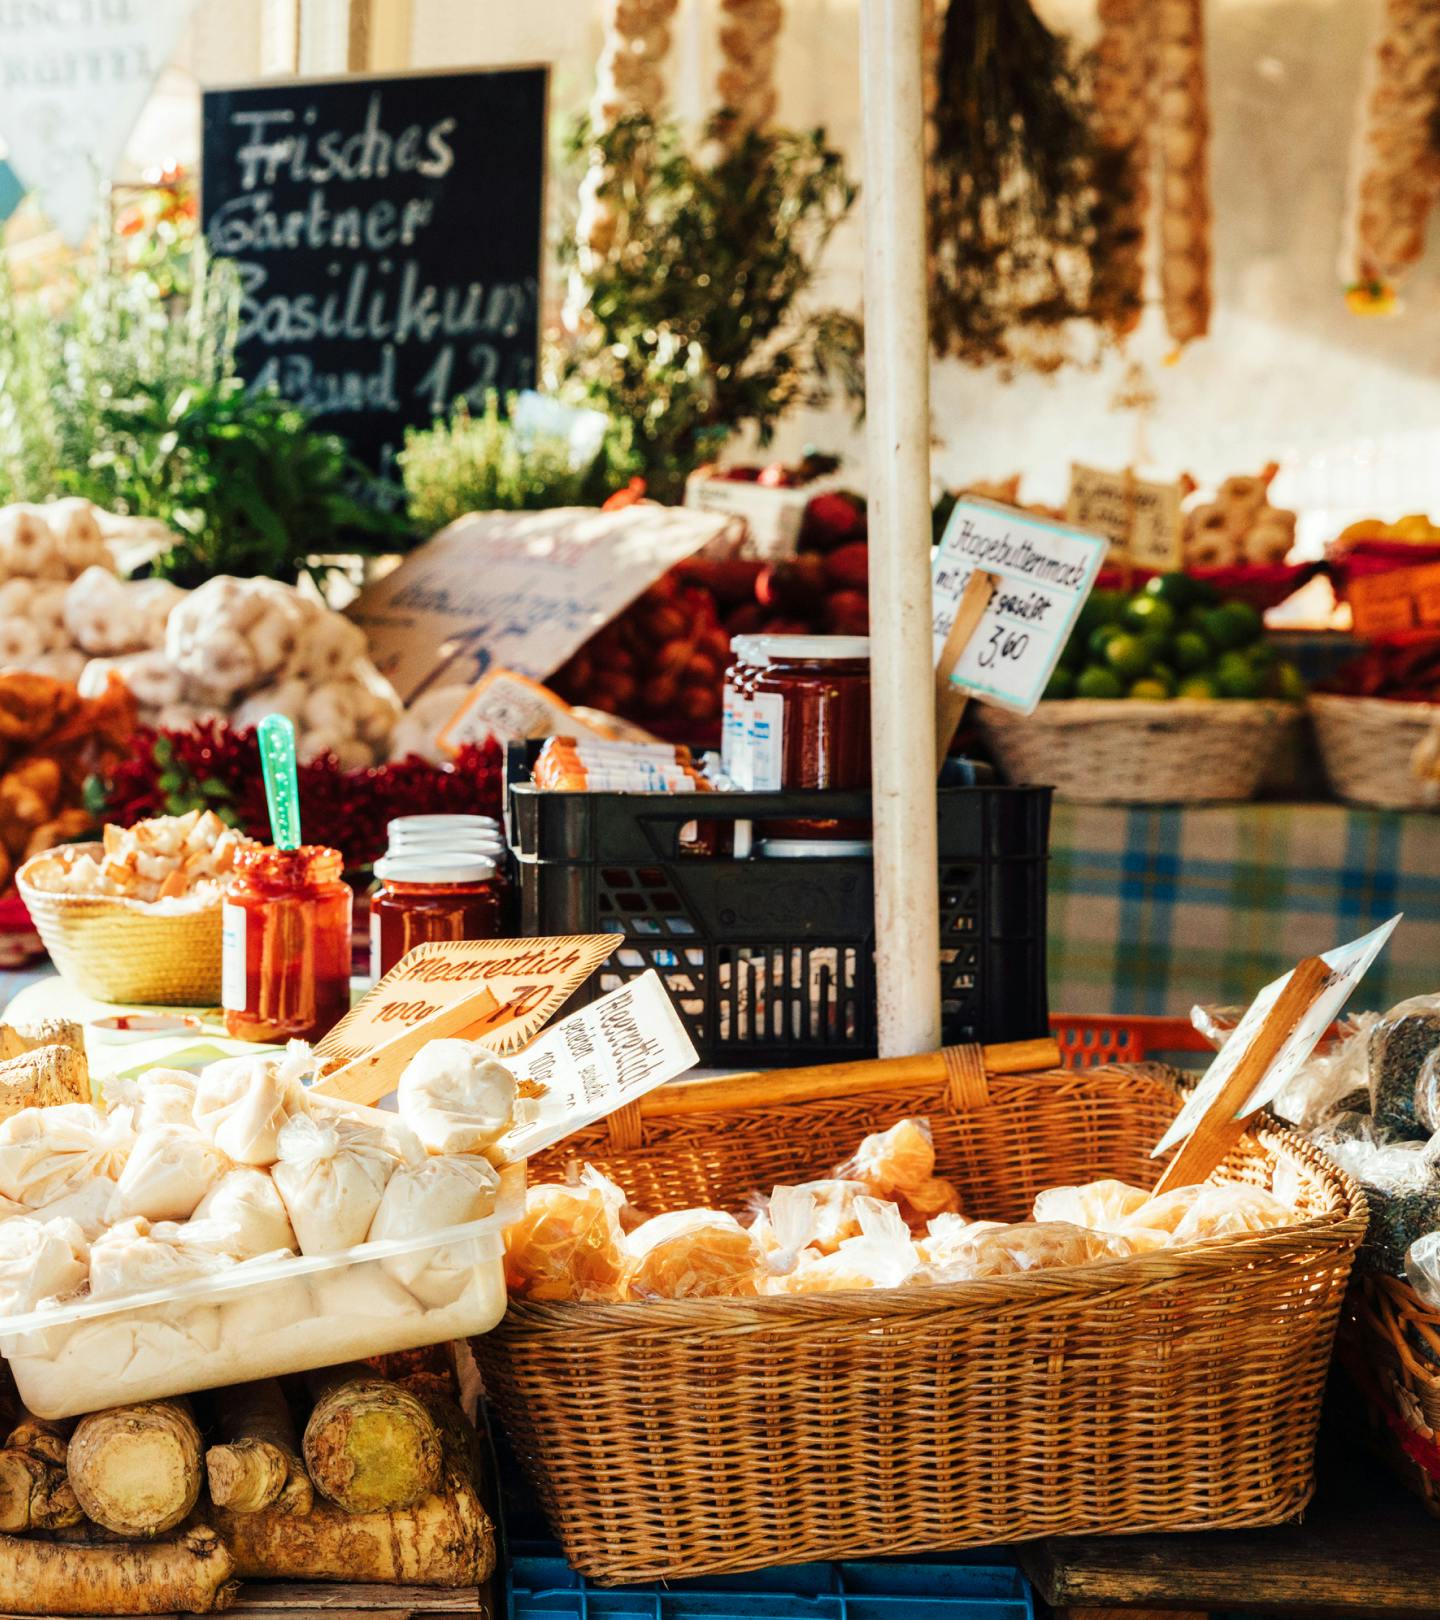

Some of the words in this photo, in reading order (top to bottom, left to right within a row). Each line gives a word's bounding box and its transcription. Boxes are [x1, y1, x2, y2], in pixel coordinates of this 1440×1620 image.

[231, 90, 457, 190] Frisches
[401, 946, 581, 984] Meerrettich
[560, 1018, 597, 1062] gerieben
[595, 989, 665, 1093] Meerrettich
